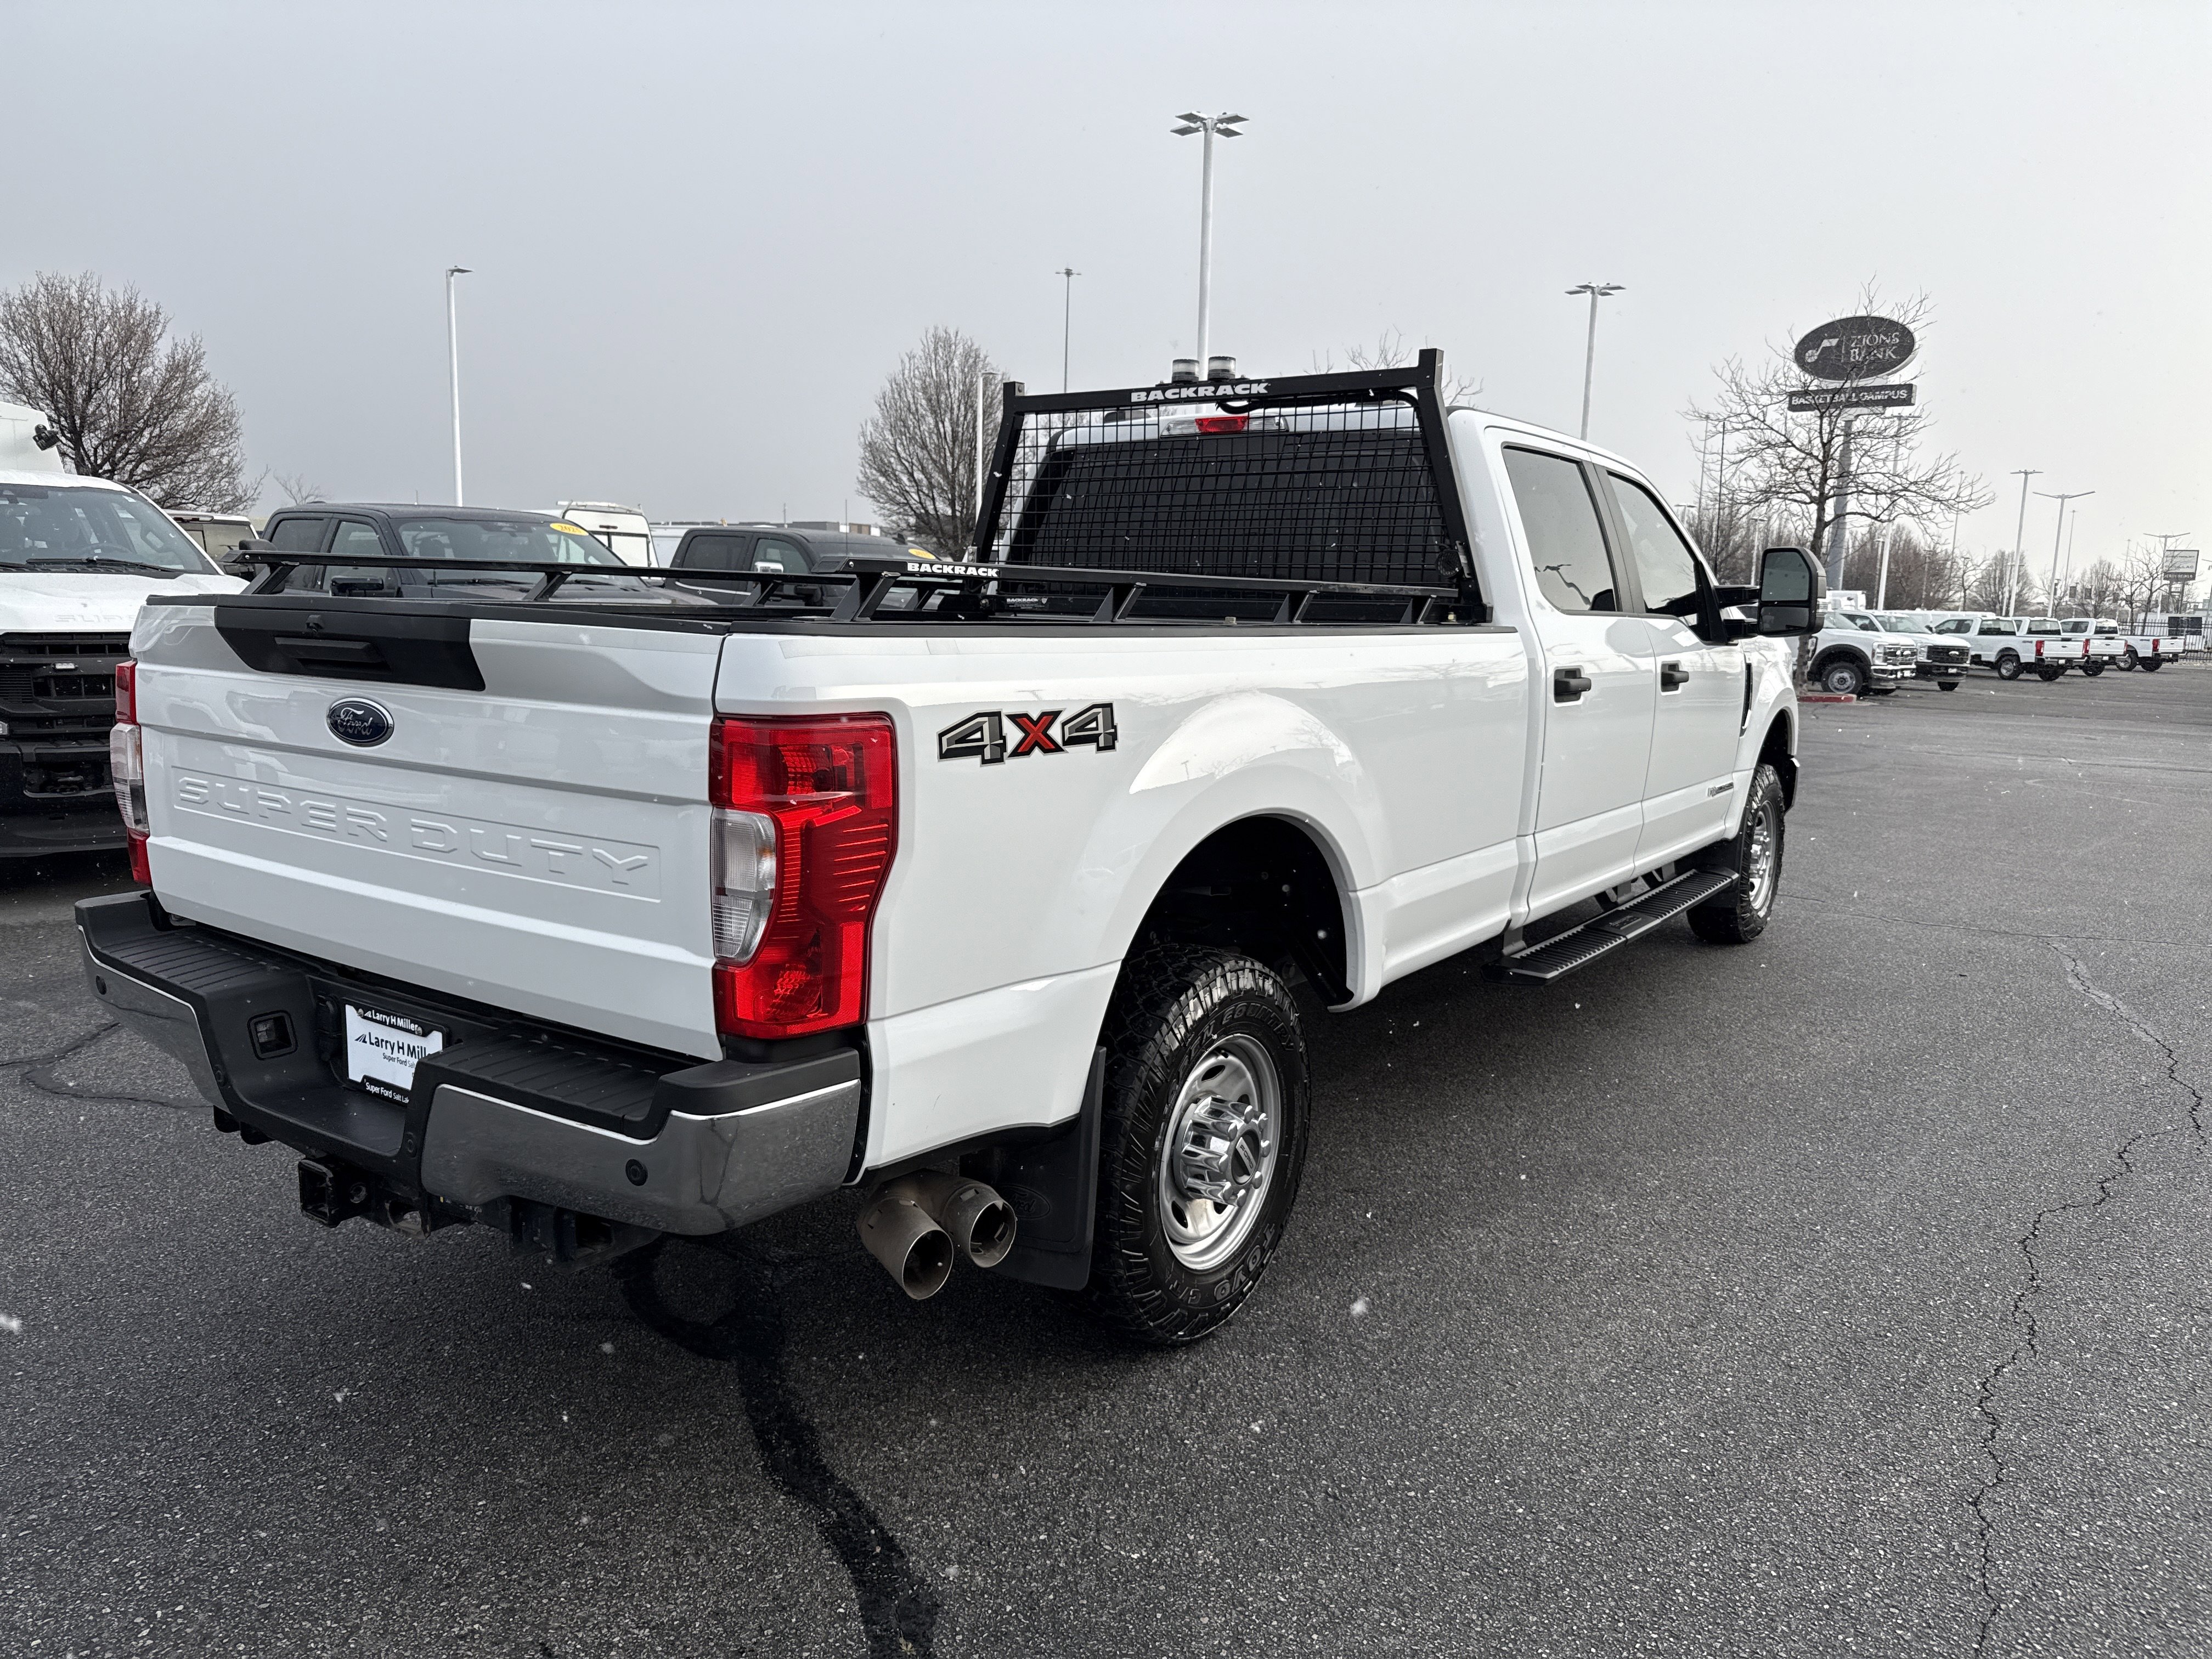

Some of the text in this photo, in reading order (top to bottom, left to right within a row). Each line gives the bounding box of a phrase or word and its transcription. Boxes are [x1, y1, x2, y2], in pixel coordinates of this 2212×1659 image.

[1850, 332, 1900, 348] ZIONS
[1849, 346, 1898, 362] BANK
[1131, 383, 1271, 402] BACKRACK
[1859, 390, 1908, 401] CAMPUS
[907, 562, 998, 577] BACKRACK
[338, 707, 373, 735] Ford
[179, 776, 648, 885] SUPER DUTY
[372, 1009, 419, 1031] Larry H Miller
[368, 1031, 428, 1059] Larry H Mill
[383, 1052, 396, 1063] Super
[397, 1057, 407, 1066] Ford
[366, 1082, 380, 1094] Super
[381, 1087, 392, 1098] Ford
[393, 1092, 402, 1102] Salt
[1240, 1144, 1254, 1169] FORD
[1214, 1223, 1276, 1301] TOYO
